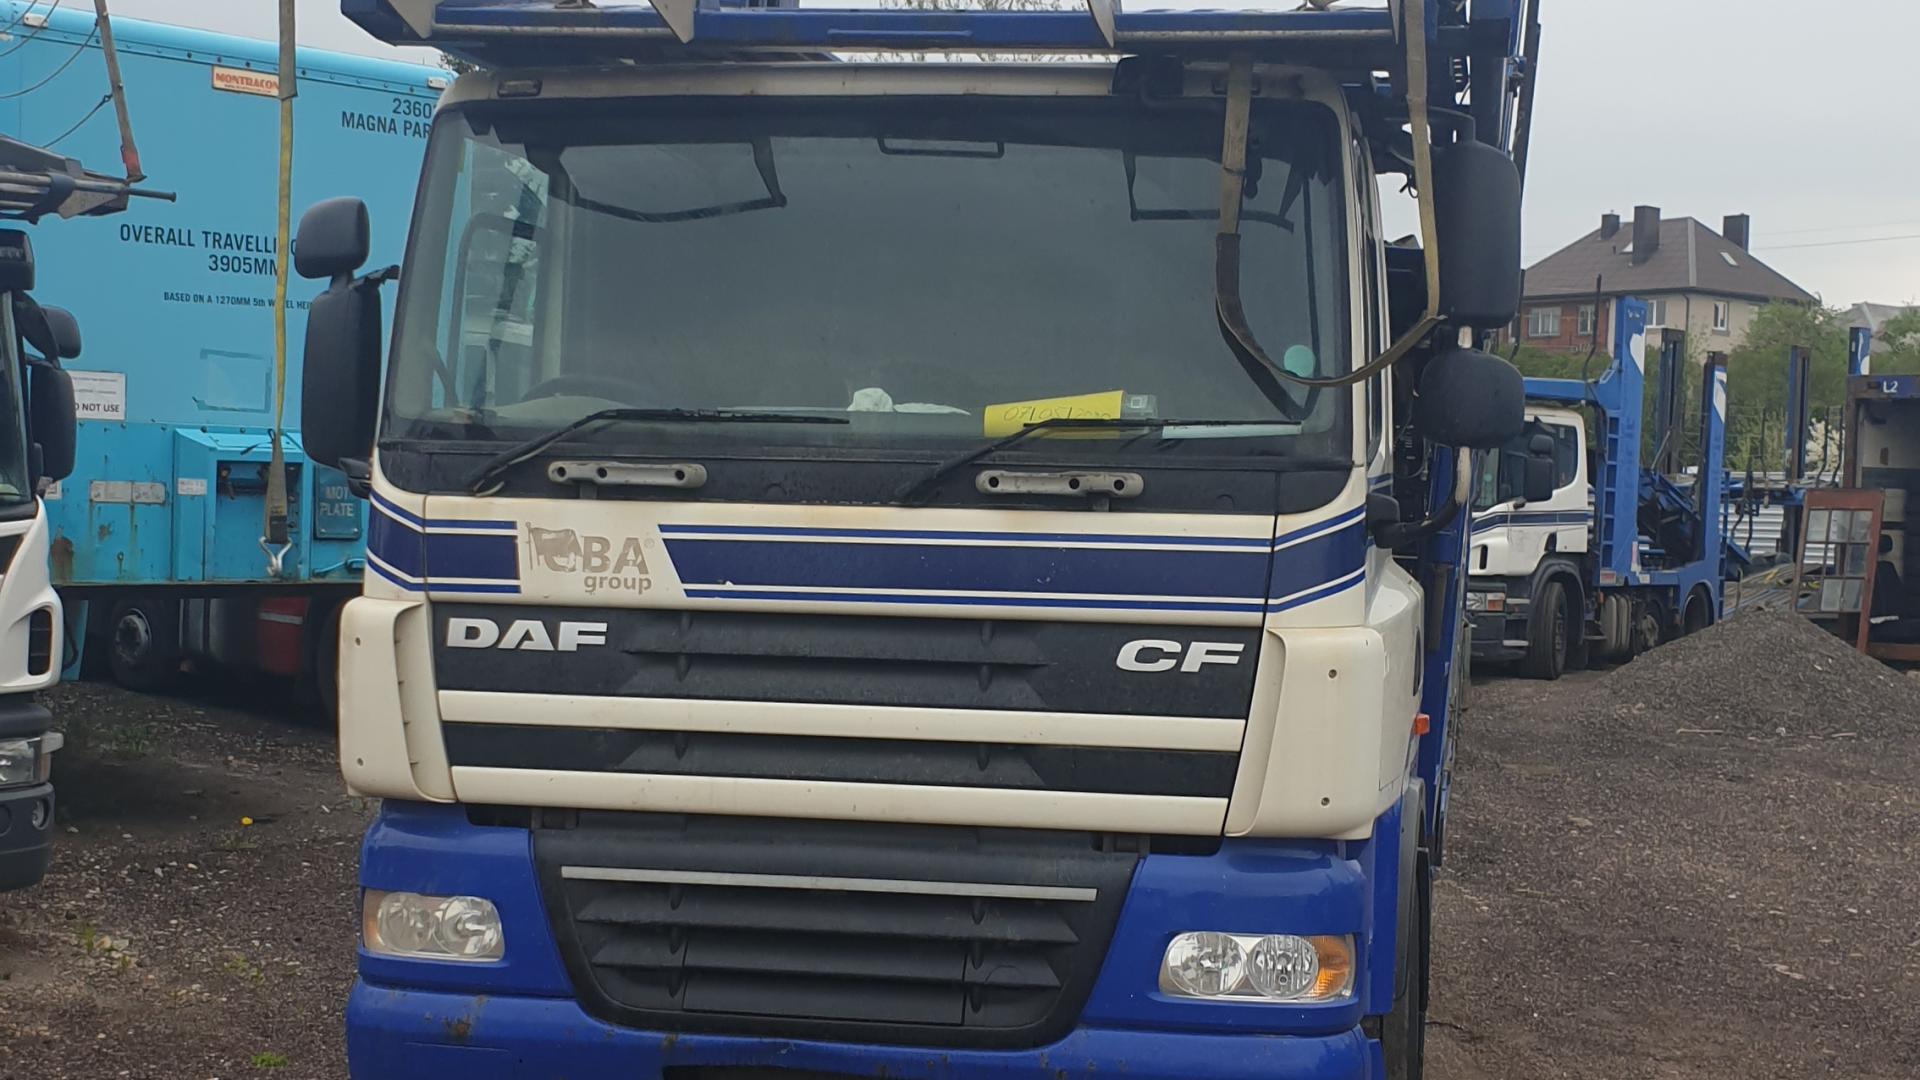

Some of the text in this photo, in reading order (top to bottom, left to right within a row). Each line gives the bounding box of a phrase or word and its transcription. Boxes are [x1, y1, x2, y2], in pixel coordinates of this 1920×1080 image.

[392, 98, 436, 119] 2360
[341, 110, 398, 135] MAGNA
[120, 223, 296, 256] OVERALL TRAVELLI
[163, 291, 191, 303] BASED
[192, 293, 205, 304] ON
[206, 294, 215, 304] A
[215, 295, 251, 306] 1270MM
[1883, 380, 1898, 393] L2
[82, 402, 101, 412] NOT
[103, 403, 120, 413] USE
[320, 502, 354, 517] PLATE
[583, 575, 653, 595] group
[447, 617, 608, 651] DAF
[1116, 639, 1246, 672] CF
